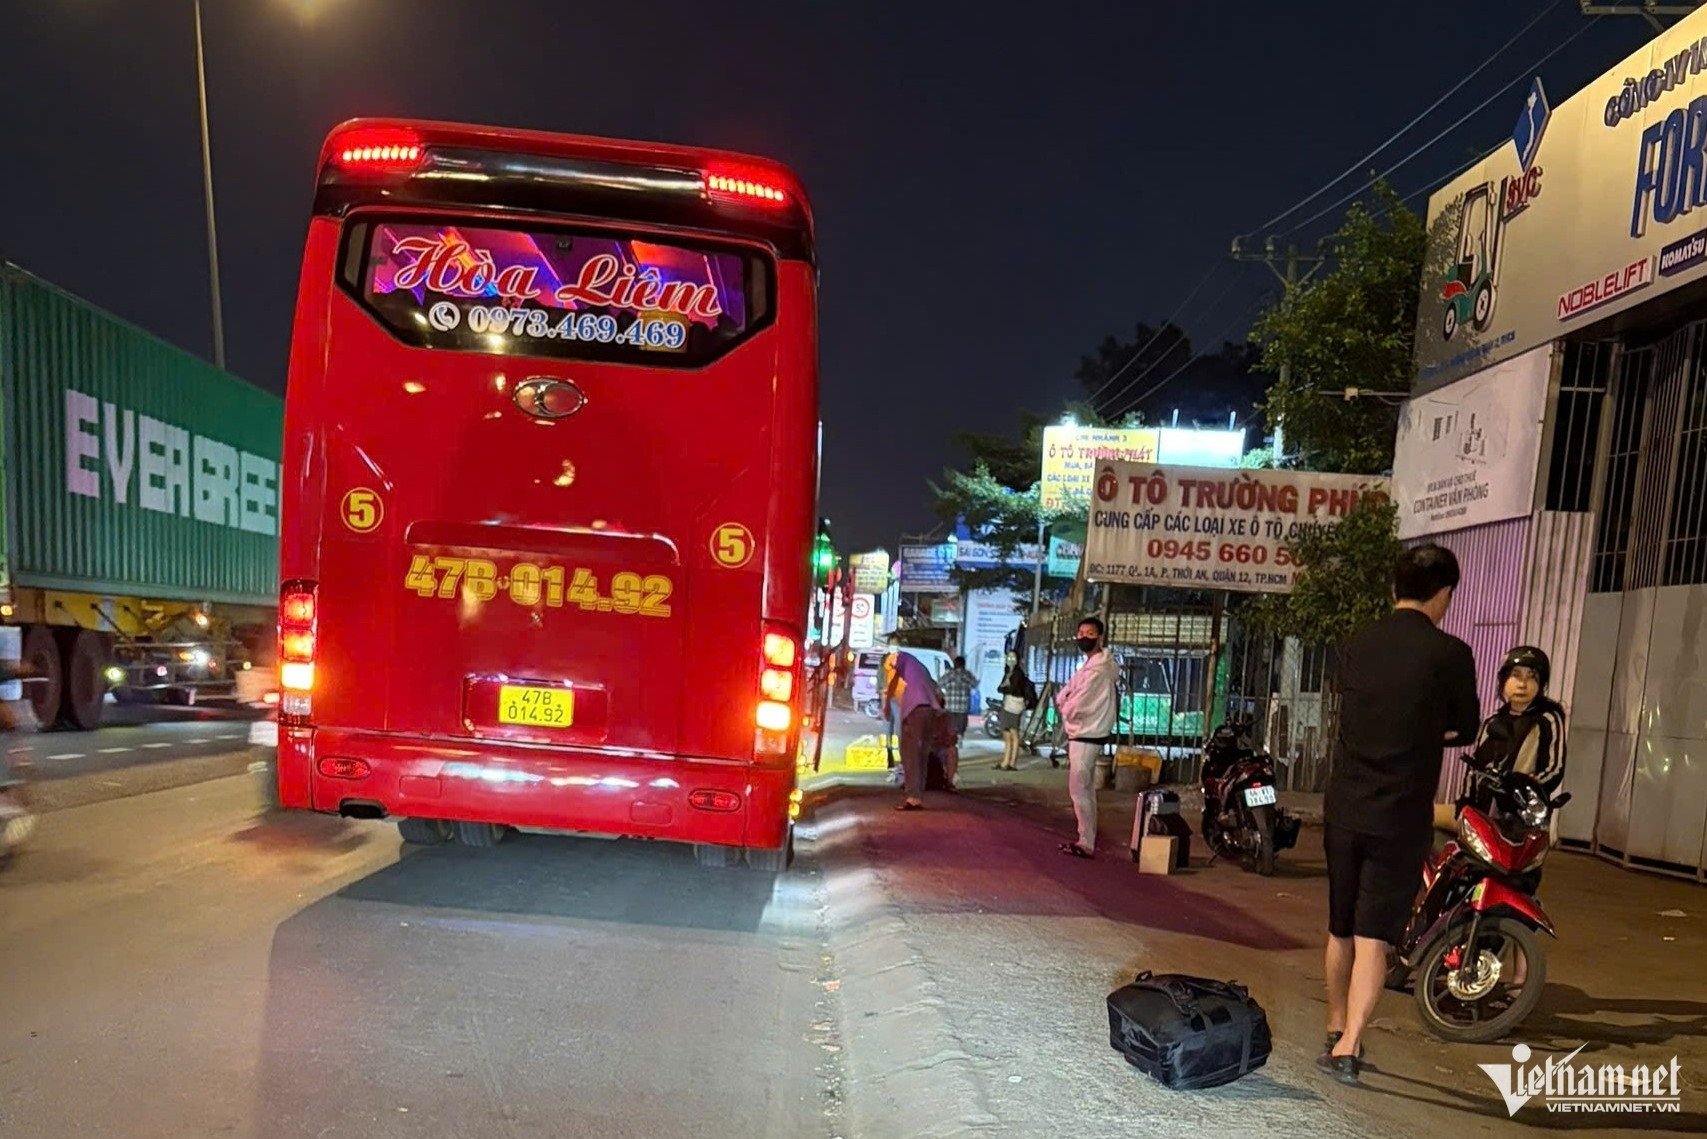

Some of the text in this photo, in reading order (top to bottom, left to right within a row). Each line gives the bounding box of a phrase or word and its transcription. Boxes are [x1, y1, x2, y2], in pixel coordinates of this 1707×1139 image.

[1631, 95, 1707, 238] FOR
[1661, 238, 1705, 269] KOMATSU
[393, 236, 722, 318] Hòa Liêm
[1558, 258, 1647, 316] NOBLELIFT
[468, 307, 686, 348] 0973.469.469
[65, 388, 283, 537] EVERGREE
[1049, 444, 1057, 459] Ô
[1061, 444, 1074, 460] TÔ
[1097, 466, 1119, 502] Ô
[1129, 469, 1168, 505] TÔ
[1178, 473, 1299, 514] TRƯỜNG
[349, 492, 374, 528] 5
[1094, 510, 1130, 529] CUNG
[1134, 507, 1160, 531] CẤP
[1164, 511, 1191, 532] CÁC
[1194, 515, 1224, 538] LOẠI
[1228, 518, 1246, 536] XE
[1251, 515, 1260, 537] Ô
[1265, 517, 1283, 540] TÔ
[718, 528, 745, 565] 5
[1148, 539, 1211, 561] 0945
[1219, 543, 1268, 565] 660
[1106, 564, 1126, 575] 1177
[508, 701, 564, 723] 014.92
[522, 690, 553, 706] 47B
